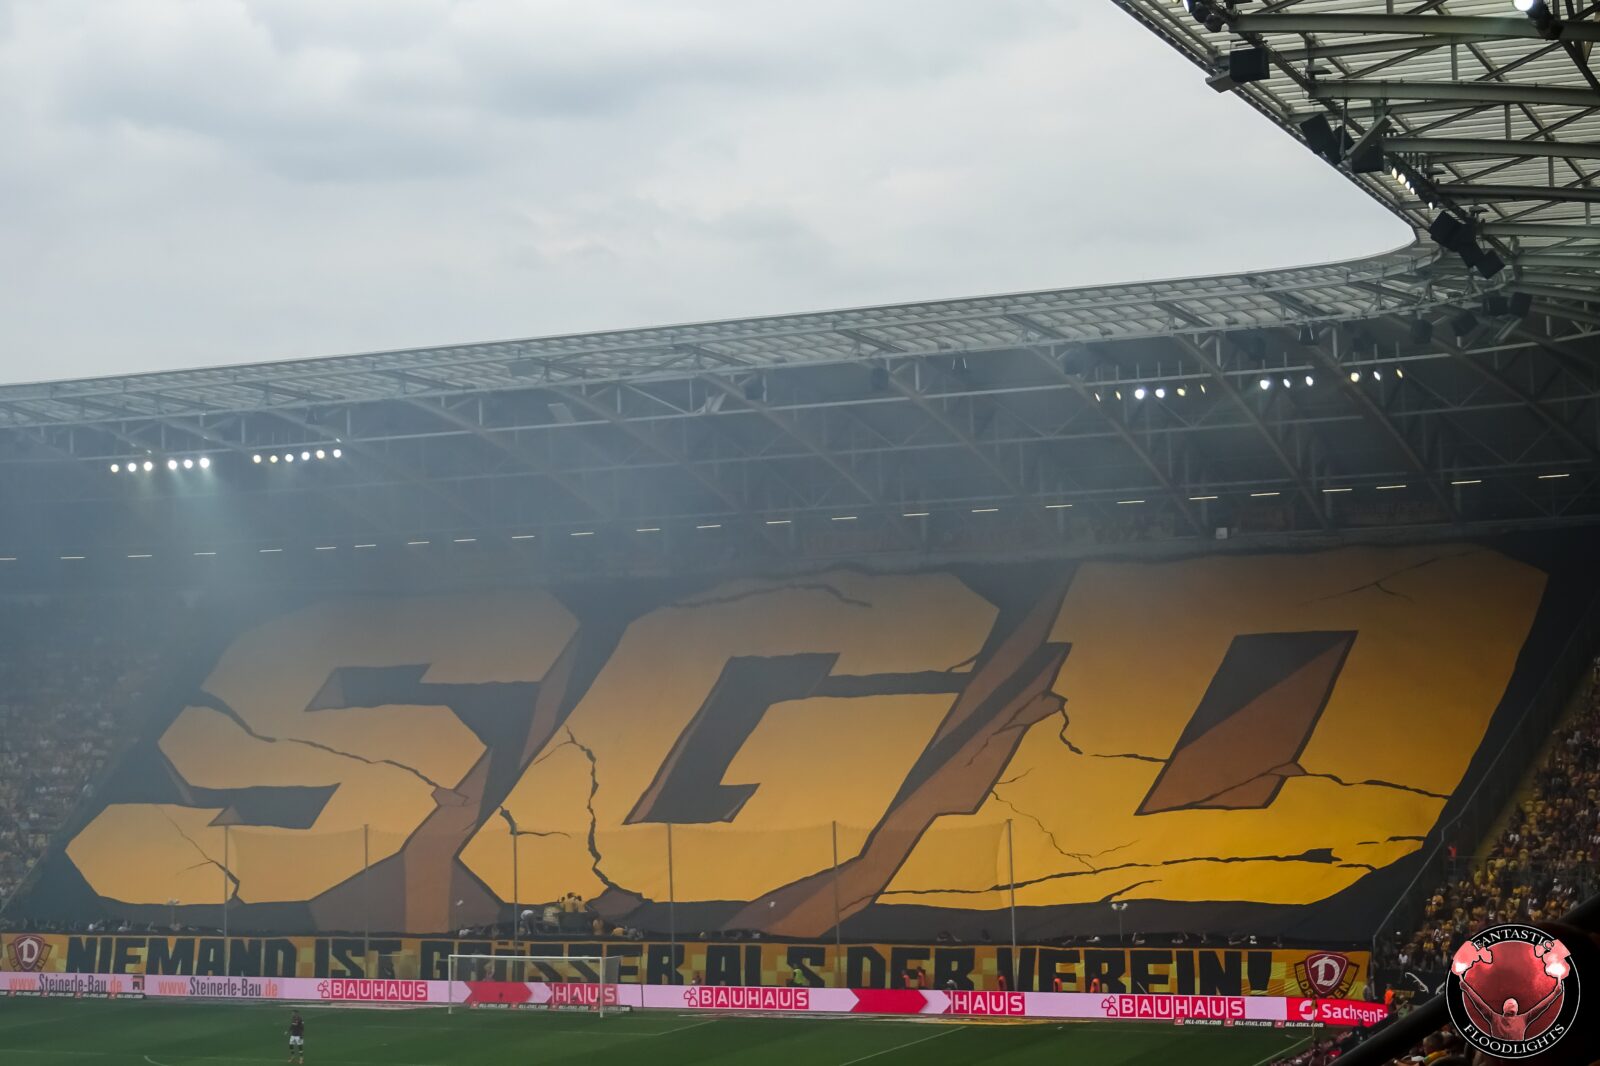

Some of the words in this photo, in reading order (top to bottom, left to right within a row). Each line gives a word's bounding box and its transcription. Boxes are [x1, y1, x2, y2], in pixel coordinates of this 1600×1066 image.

[66, 936, 297, 977] NIEMAND
[314, 939, 402, 979] IST
[705, 945, 826, 988] ALS
[846, 946, 976, 989] DER
[996, 947, 1272, 996] VEREIN!
[158, 976, 278, 997] www.Steinerle-Bau.de
[331, 981, 428, 1001] BAUHAUS
[700, 987, 809, 1009] BAUHAUS
[1119, 995, 1245, 1018] BAUHAUS
